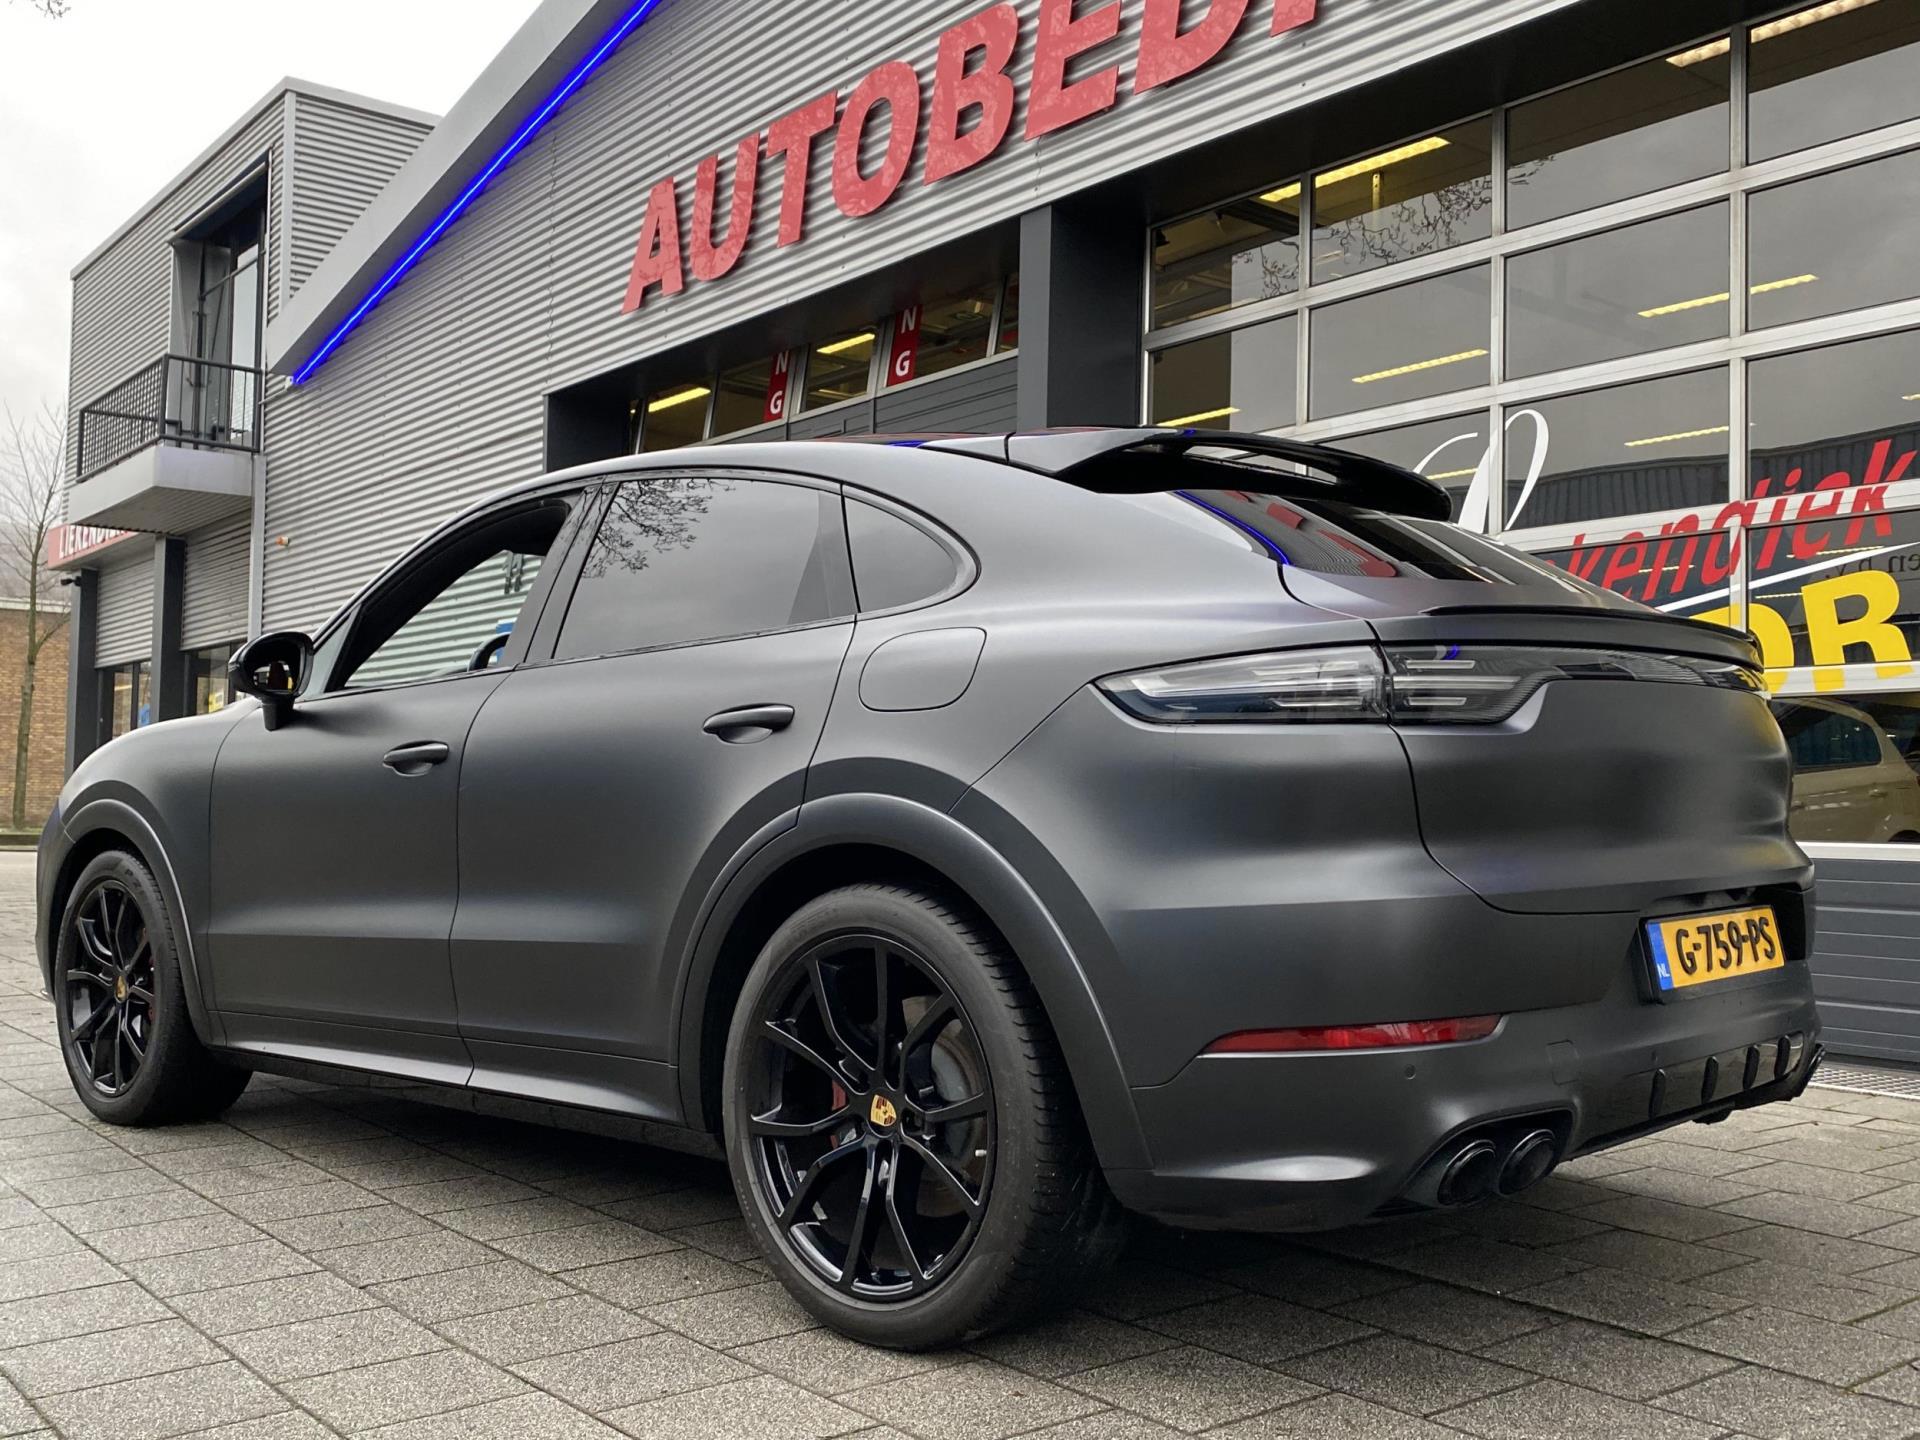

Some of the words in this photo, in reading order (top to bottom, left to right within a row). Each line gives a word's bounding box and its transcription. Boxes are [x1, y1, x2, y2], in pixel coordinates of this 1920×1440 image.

[622, 0, 1317, 313] AUTOBED
[1544, 440, 1918, 600] kendiek
[1657, 964, 1670, 978] NL
[1676, 916, 1776, 975] G-759-PS
